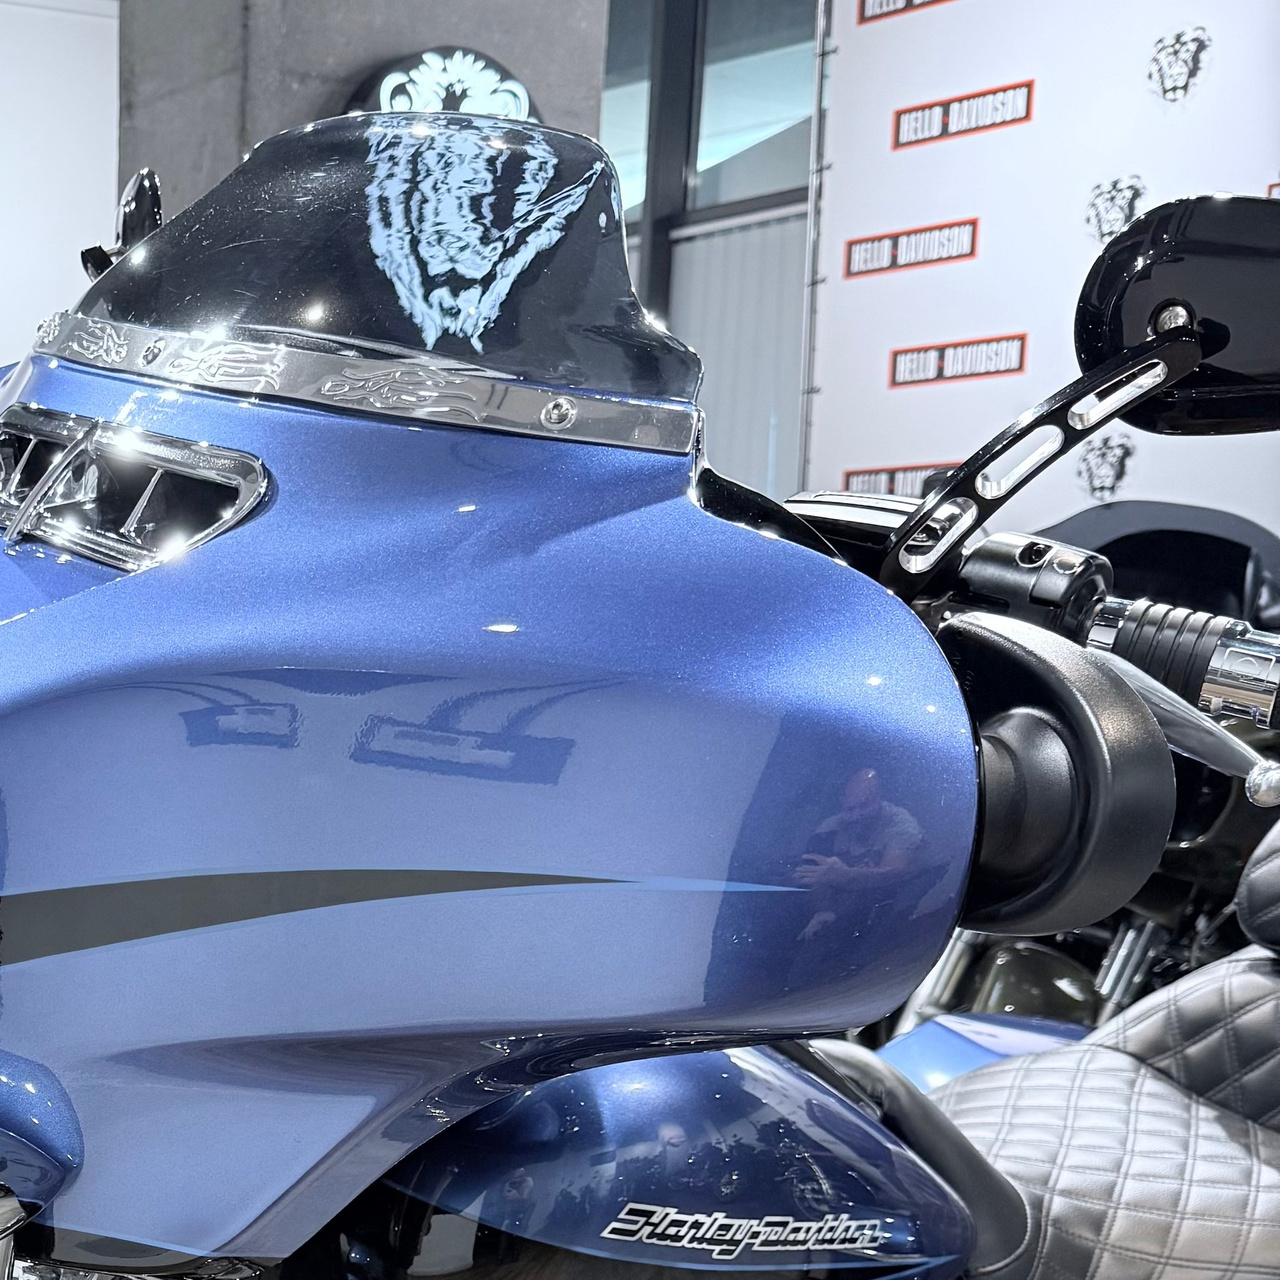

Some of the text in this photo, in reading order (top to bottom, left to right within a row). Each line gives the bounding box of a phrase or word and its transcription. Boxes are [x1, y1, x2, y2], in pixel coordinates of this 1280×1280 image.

[899, 85, 1029, 145] HELLO DAVIDSON
[850, 223, 974, 274] HELLO DAVIDSON
[895, 338, 1023, 384] HELLO DAVIDSON
[600, 1202, 885, 1260] Harley-Davidson
